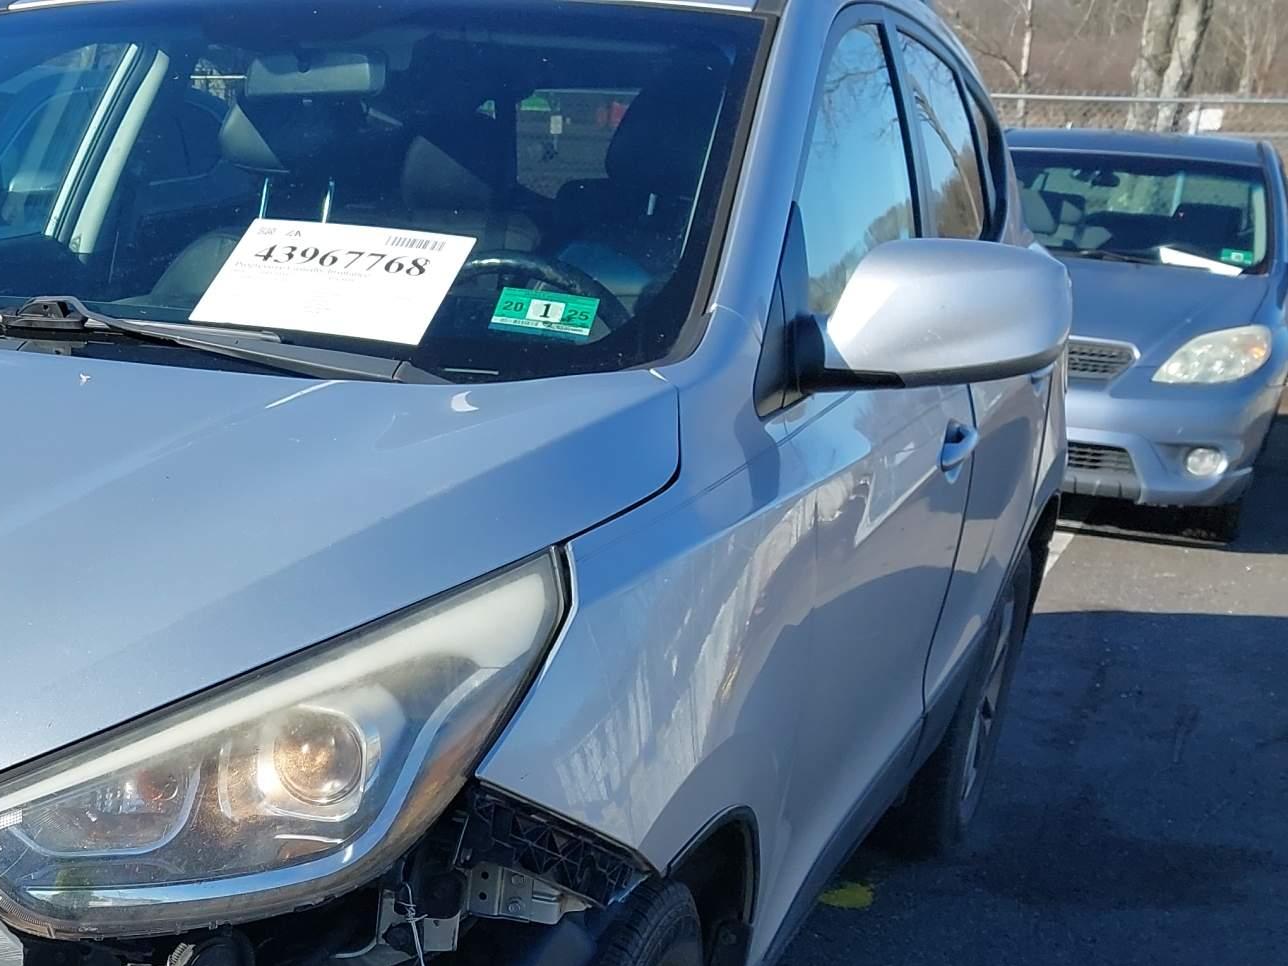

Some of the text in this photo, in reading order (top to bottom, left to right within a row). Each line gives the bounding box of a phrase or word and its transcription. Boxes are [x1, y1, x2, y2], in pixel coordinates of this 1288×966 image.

[253, 243, 431, 277] 43967768
[502, 300, 590, 321] 20 1 25
